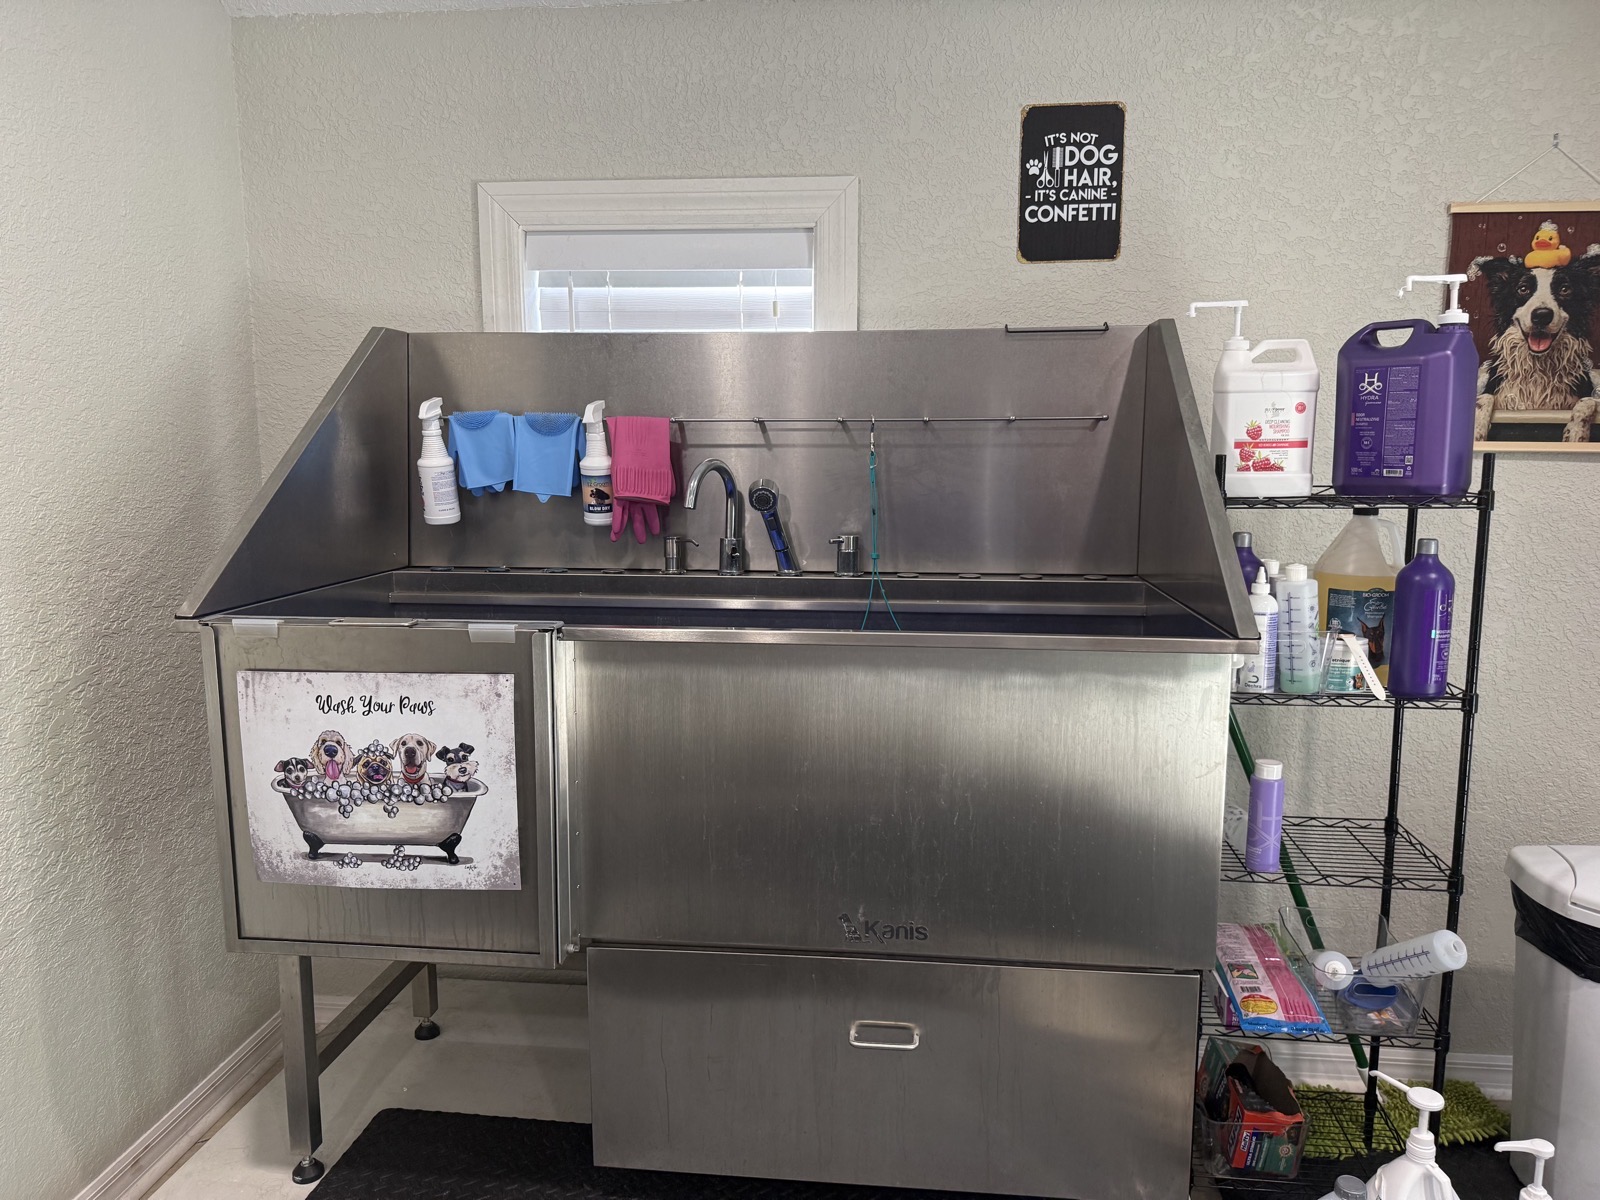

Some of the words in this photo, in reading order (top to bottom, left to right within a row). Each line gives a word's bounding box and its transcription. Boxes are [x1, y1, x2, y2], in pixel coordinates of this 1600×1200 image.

[1044, 132, 1067, 147] IT'S
[1070, 132, 1099, 145] NOT
[1064, 144, 1119, 167] DOG
[1063, 168, 1118, 188] HAIR,
[1034, 189, 1057, 202] IT'S
[1059, 188, 1108, 201] CANINE
[1024, 203, 1117, 223] CONFETTI
[315, 694, 357, 716] Wash
[360, 695, 395, 717] Your
[399, 695, 437, 717] Paws
[864, 920, 929, 944] Kanis
